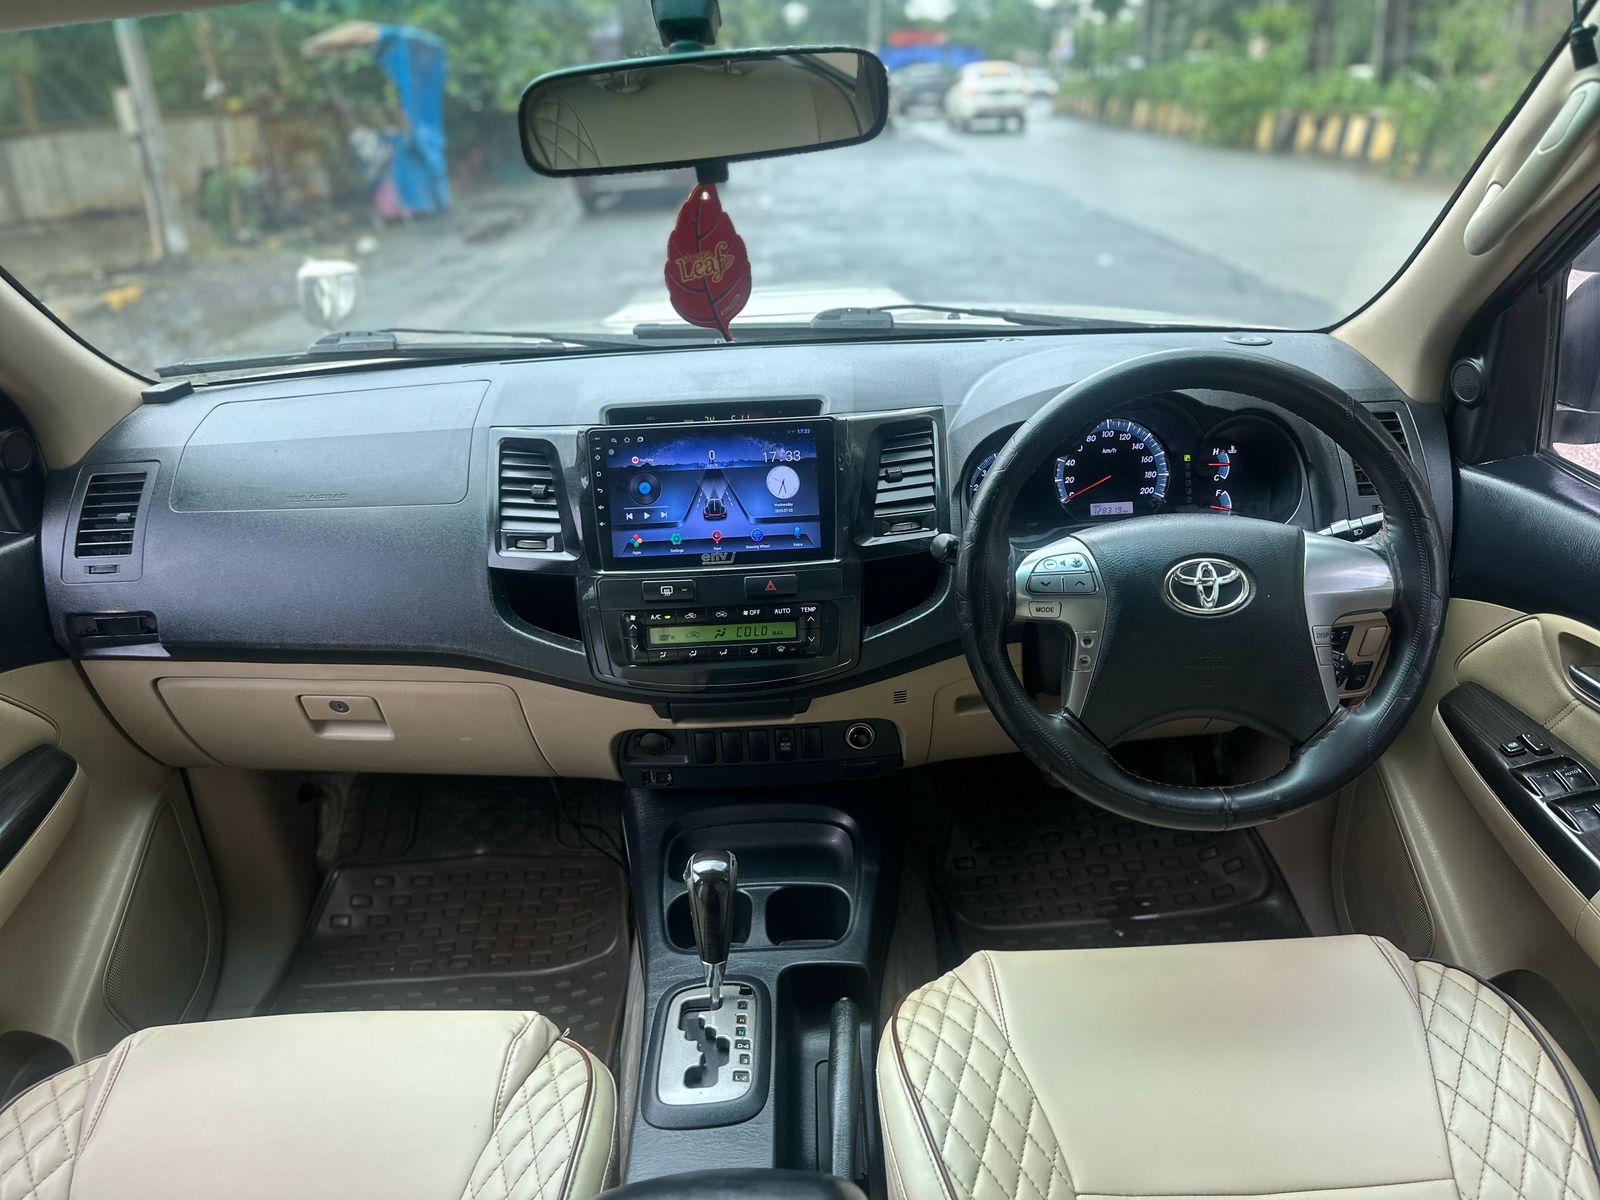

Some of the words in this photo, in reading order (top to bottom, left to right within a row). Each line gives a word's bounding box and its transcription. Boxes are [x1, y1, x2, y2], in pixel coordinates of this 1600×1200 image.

[675, 241, 728, 283] Leaf
[1086, 434, 1096, 442] 80
[1102, 430, 1114, 438] 100
[1119, 433, 1131, 441] 120
[1132, 442, 1144, 450] 140
[708, 449, 716, 460] 0
[762, 449, 801, 463] 17:33
[1212, 448, 1219, 456] H
[1065, 459, 1076, 467] 40
[1144, 471, 1157, 479] 180
[1064, 476, 1075, 484] 20
[1140, 487, 1155, 495] 200
[1215, 489, 1222, 497] F
[736, 625, 769, 638] COLD
